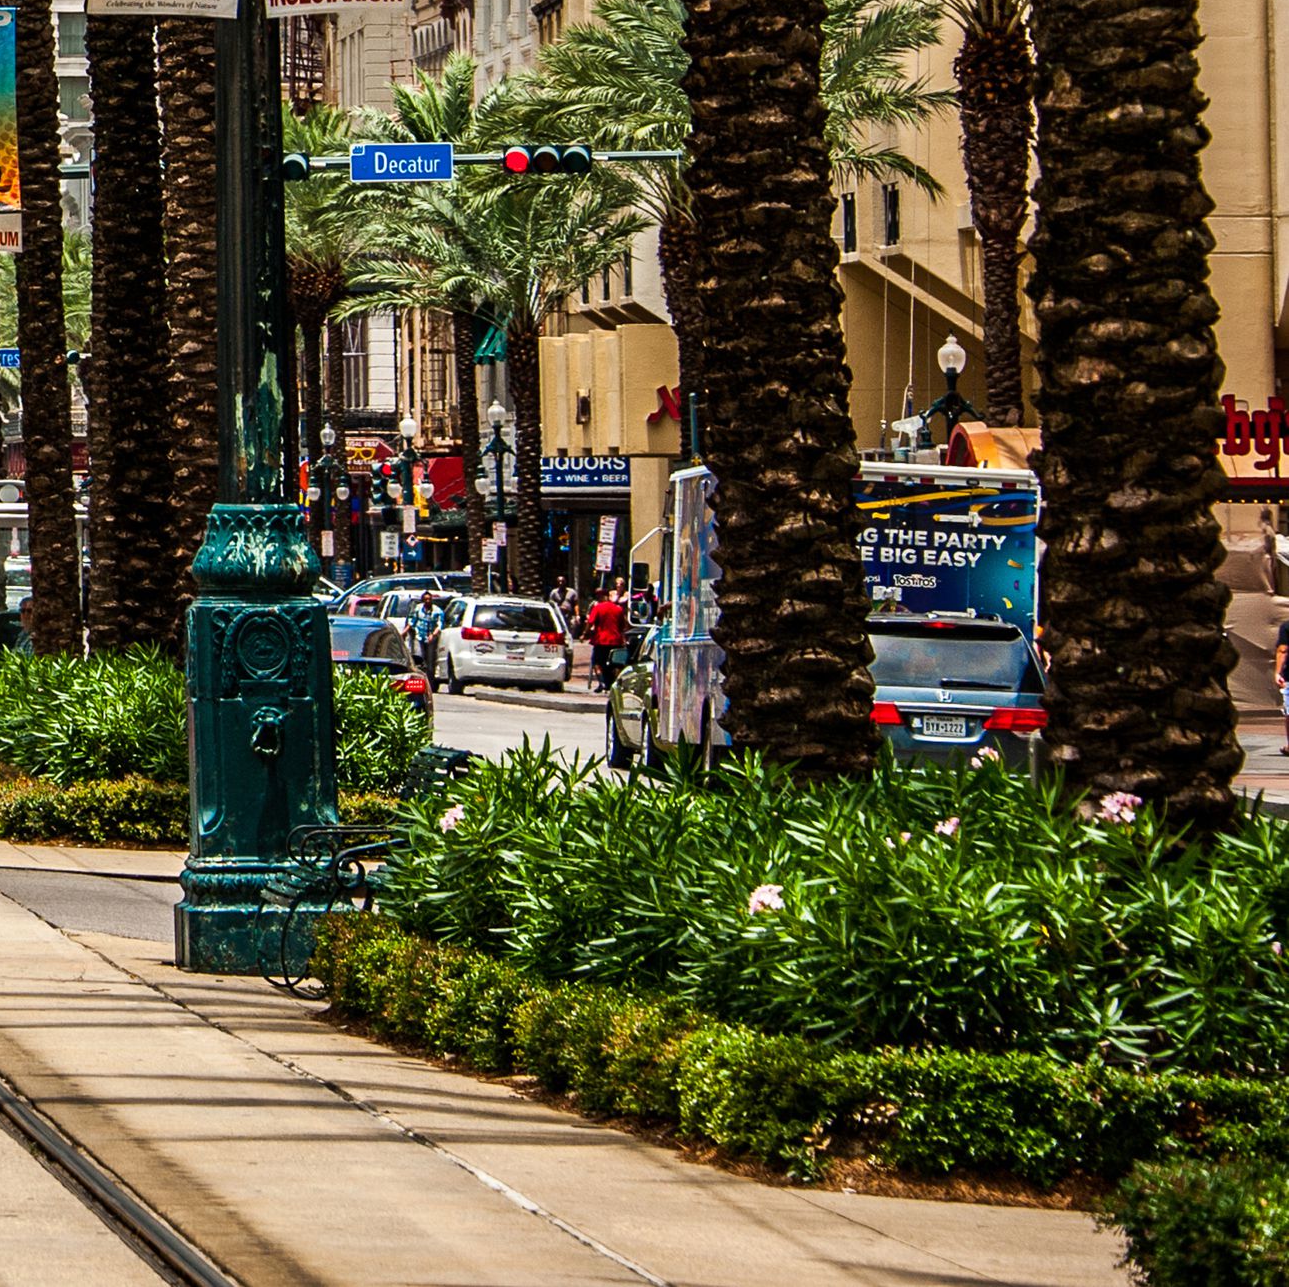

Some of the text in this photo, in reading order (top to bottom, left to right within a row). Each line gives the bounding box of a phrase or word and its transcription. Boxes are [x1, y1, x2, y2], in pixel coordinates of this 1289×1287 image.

[374, 151, 440, 174] Decatur
[540, 457, 626, 470] LIQUORS
[565, 474, 589, 482] WINE
[602, 474, 628, 482] BEER
[884, 529, 928, 547] THE
[934, 531, 1006, 550] PARTY
[880, 547, 917, 565] BIG
[923, 550, 981, 568] EASY
